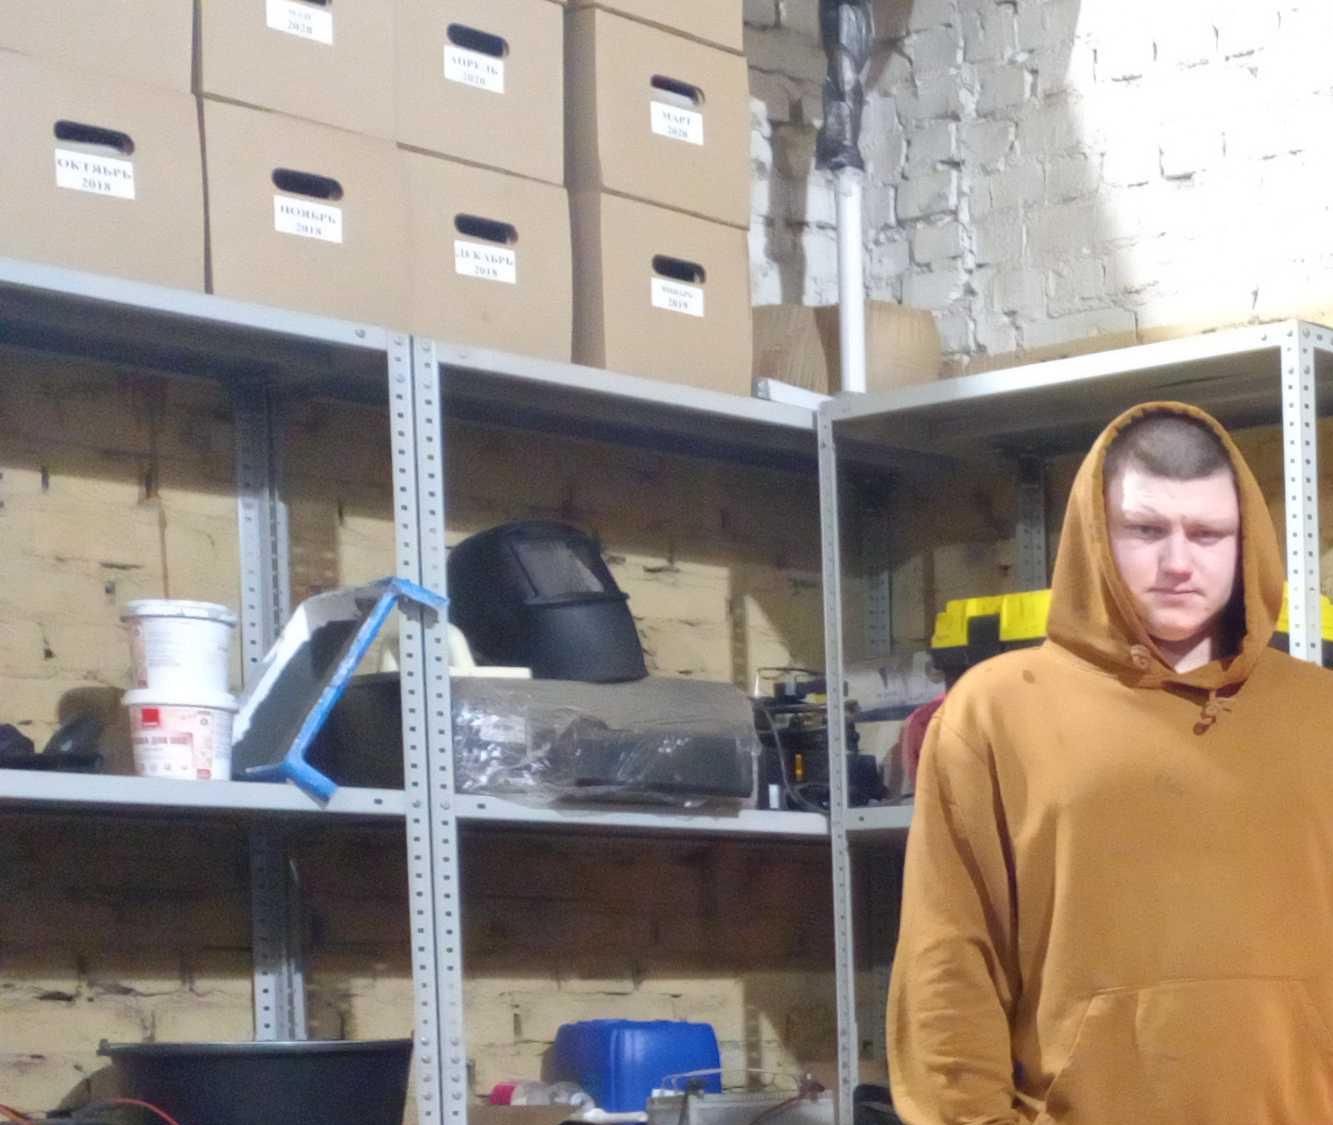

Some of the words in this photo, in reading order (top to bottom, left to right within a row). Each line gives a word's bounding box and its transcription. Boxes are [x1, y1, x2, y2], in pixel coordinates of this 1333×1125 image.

[57, 158, 132, 179] ОКТЯБРЬ
[82, 177, 111, 192] 2018
[280, 204, 337, 224] НОЯБРЬ
